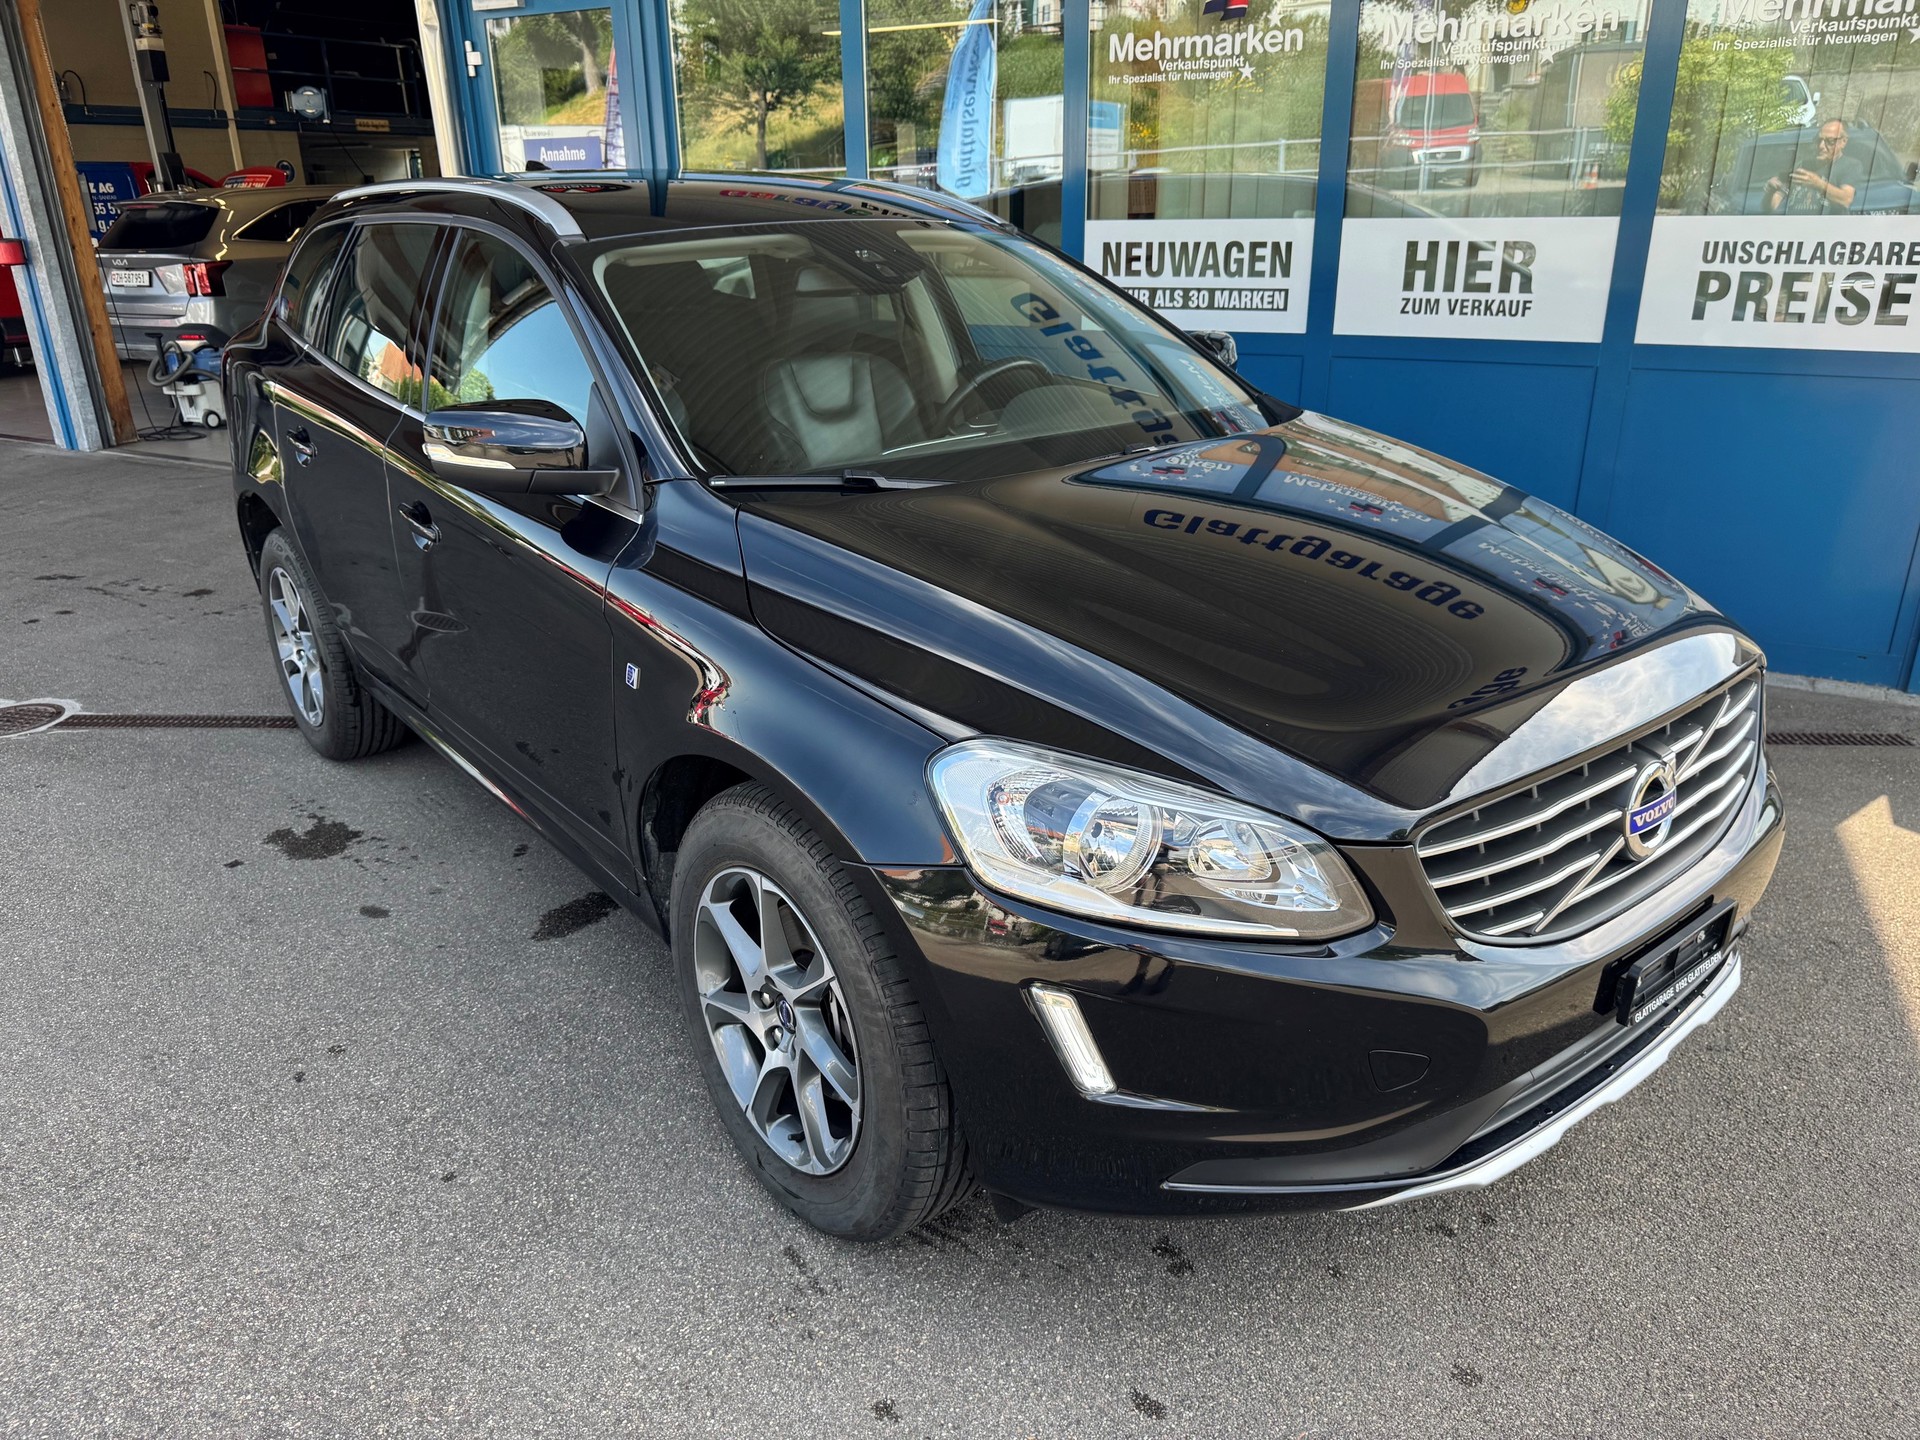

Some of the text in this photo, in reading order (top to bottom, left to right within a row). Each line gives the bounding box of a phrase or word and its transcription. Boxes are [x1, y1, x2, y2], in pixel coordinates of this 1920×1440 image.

[1382, 2, 1619, 46] Mehrmarken
[1790, 13, 1919, 35] Verkaufspunkt
[1109, 24, 1304, 63] Mehrmarken
[1441, 37, 1547, 56] Verkaufspunkt
[1712, 32, 1898, 51] Ihr Spezialist für Neuwagen
[1158, 55, 1245, 72] Verkaufspunkt
[1380, 59, 1395, 70] Ihr
[1396, 56, 1450, 70] Spezialist
[1108, 70, 1232, 85] Ihr Spezialist für Neuwagen
[540, 146, 586, 162] Annahme
[98, 182, 115, 193] AG
[1102, 241, 1293, 279] NEUWAGEN
[1702, 240, 1920, 266] UNSCHLAGBARE
[1402, 240, 1537, 294] HIER
[1154, 288, 1184, 309] ALS
[1188, 289, 1208, 309] 30
[1213, 290, 1285, 310] MARKEN
[1400, 297, 1533, 317] ZUM VERKAUF
[1691, 270, 1918, 326] PREISE
[1633, 796, 1674, 827] VOLVO
[1634, 988, 1675, 1023] GLATTGARAGE
[1687, 950, 1722, 983] GLATTFELDEN
